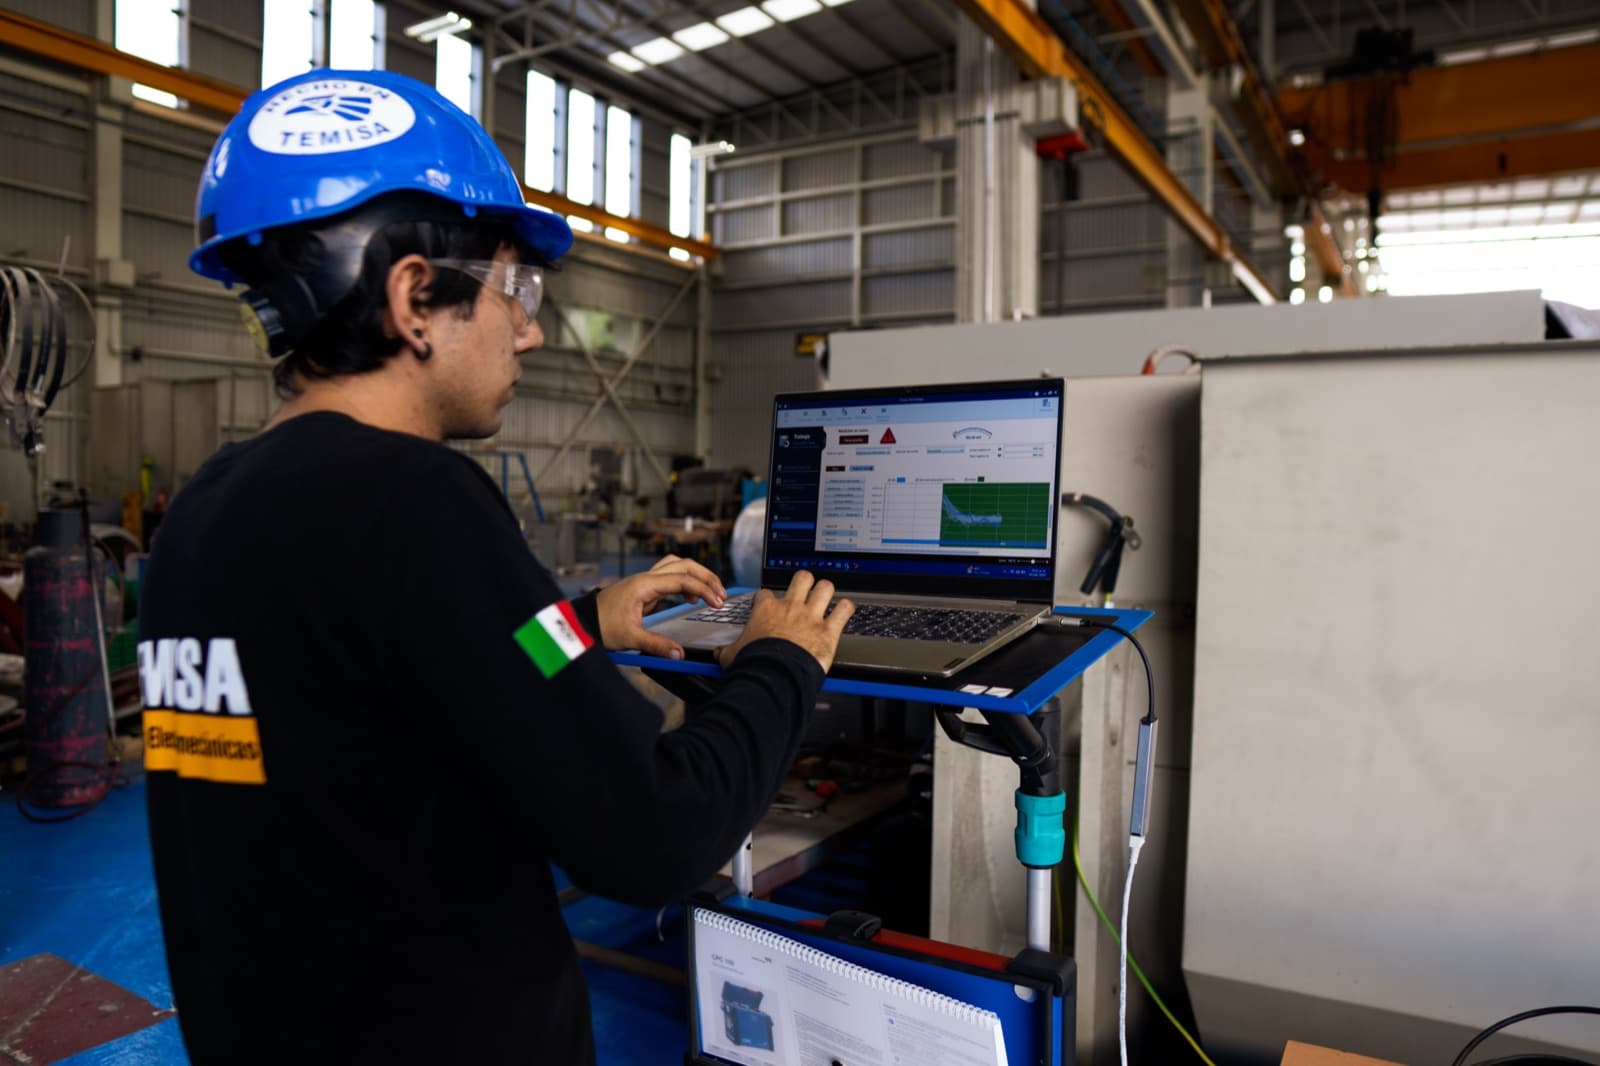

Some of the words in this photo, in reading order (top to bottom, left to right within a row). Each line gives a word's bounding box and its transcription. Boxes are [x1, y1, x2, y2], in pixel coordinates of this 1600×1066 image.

[265, 81, 349, 113] HECHO
[358, 82, 393, 101] EN
[280, 120, 391, 147] TEMISA
[137, 637, 253, 716] MSA
